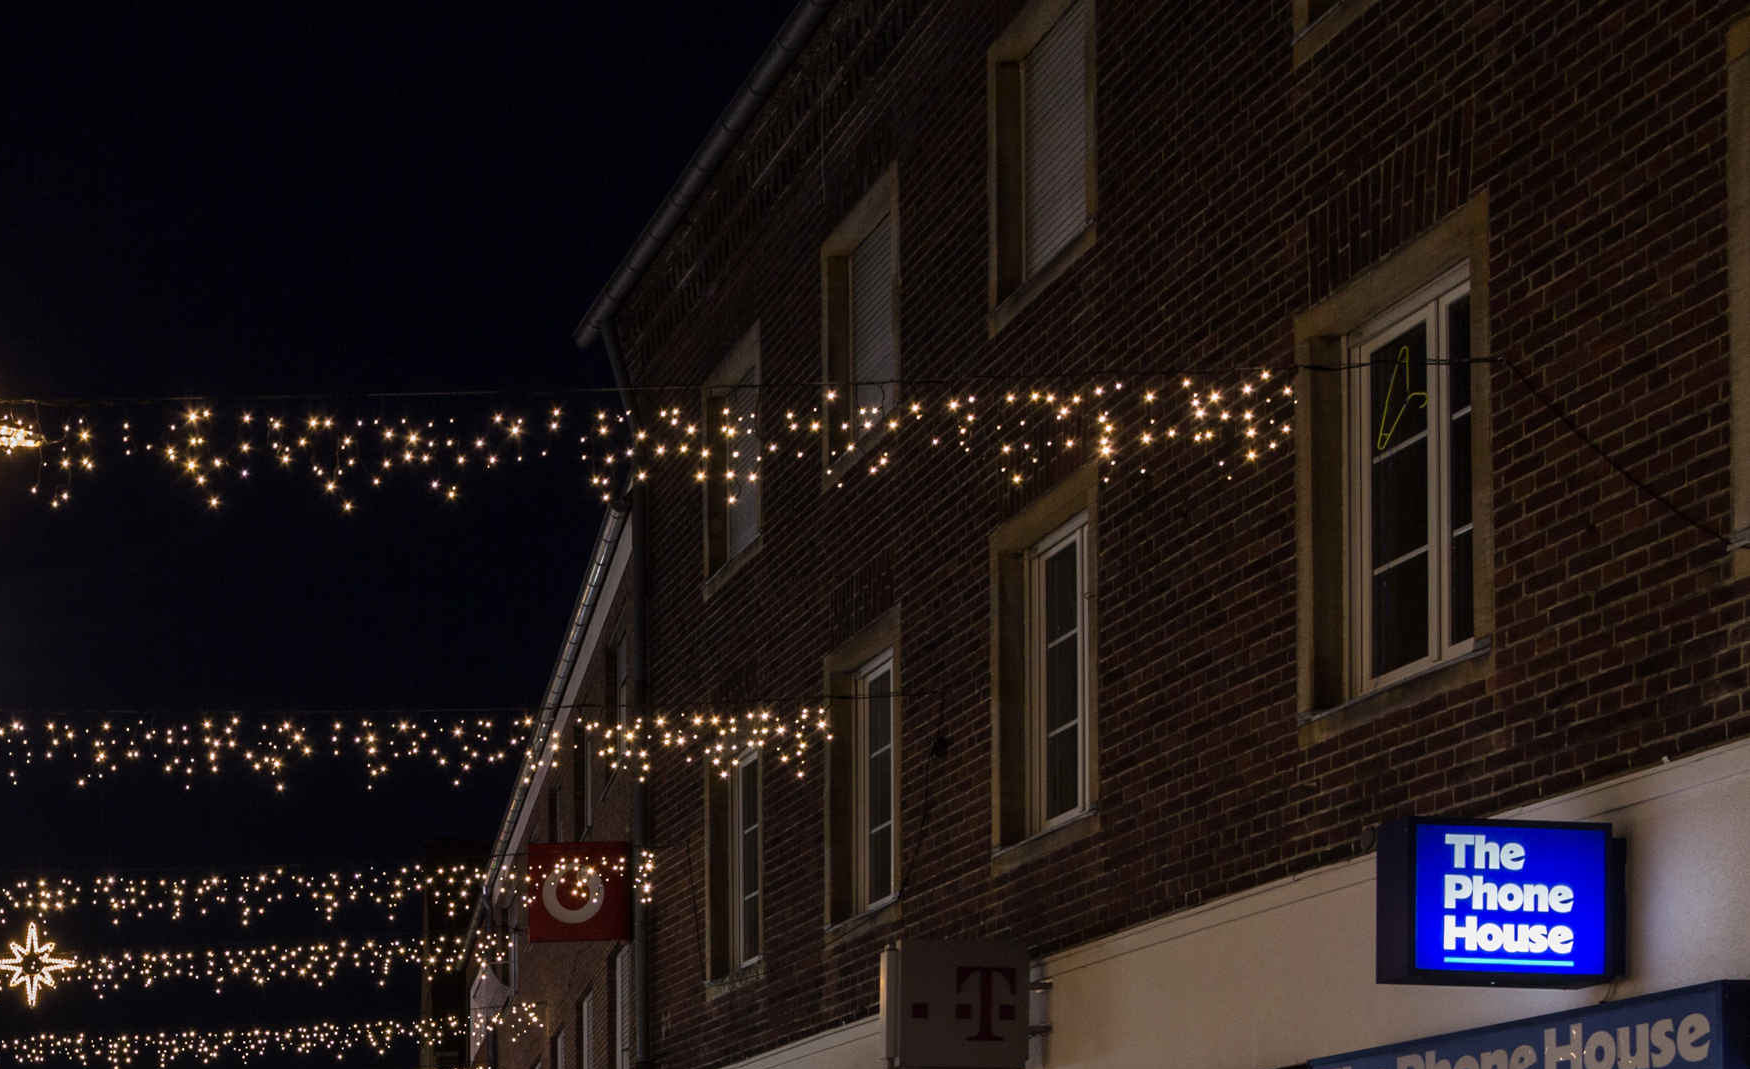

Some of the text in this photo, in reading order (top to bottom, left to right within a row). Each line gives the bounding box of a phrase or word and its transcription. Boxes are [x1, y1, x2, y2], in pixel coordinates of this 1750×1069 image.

[1445, 833, 1525, 870] The
[1444, 874, 1574, 913] Phone
[1443, 915, 1574, 954] House
